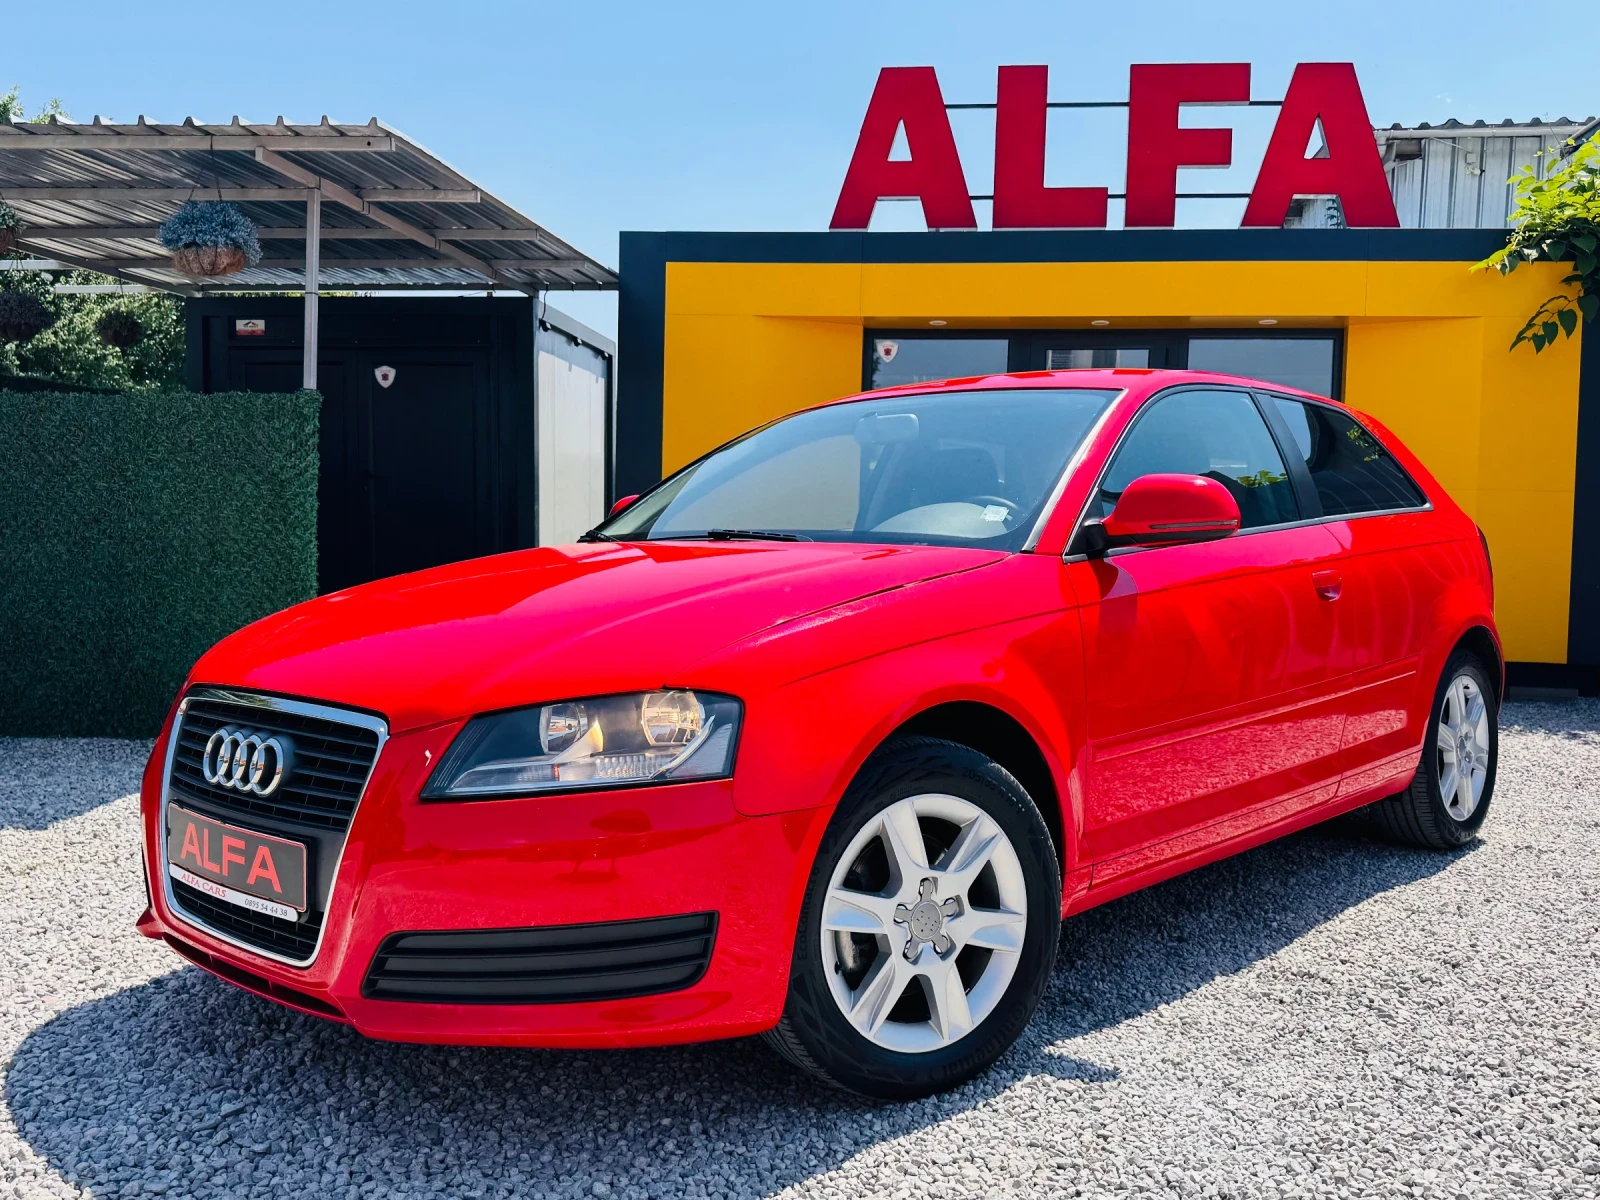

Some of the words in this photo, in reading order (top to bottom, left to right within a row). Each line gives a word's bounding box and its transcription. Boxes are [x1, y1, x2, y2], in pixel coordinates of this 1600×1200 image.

[829, 62, 1400, 230] ALFA
[180, 822, 282, 893] ALFA
[182, 873, 201, 888] ALFA
[202, 882, 227, 898] CARS
[244, 898, 259, 909] 0895
[260, 902, 268, 912] 54
[269, 905, 278, 914] 44
[279, 908, 288, 917] 38
